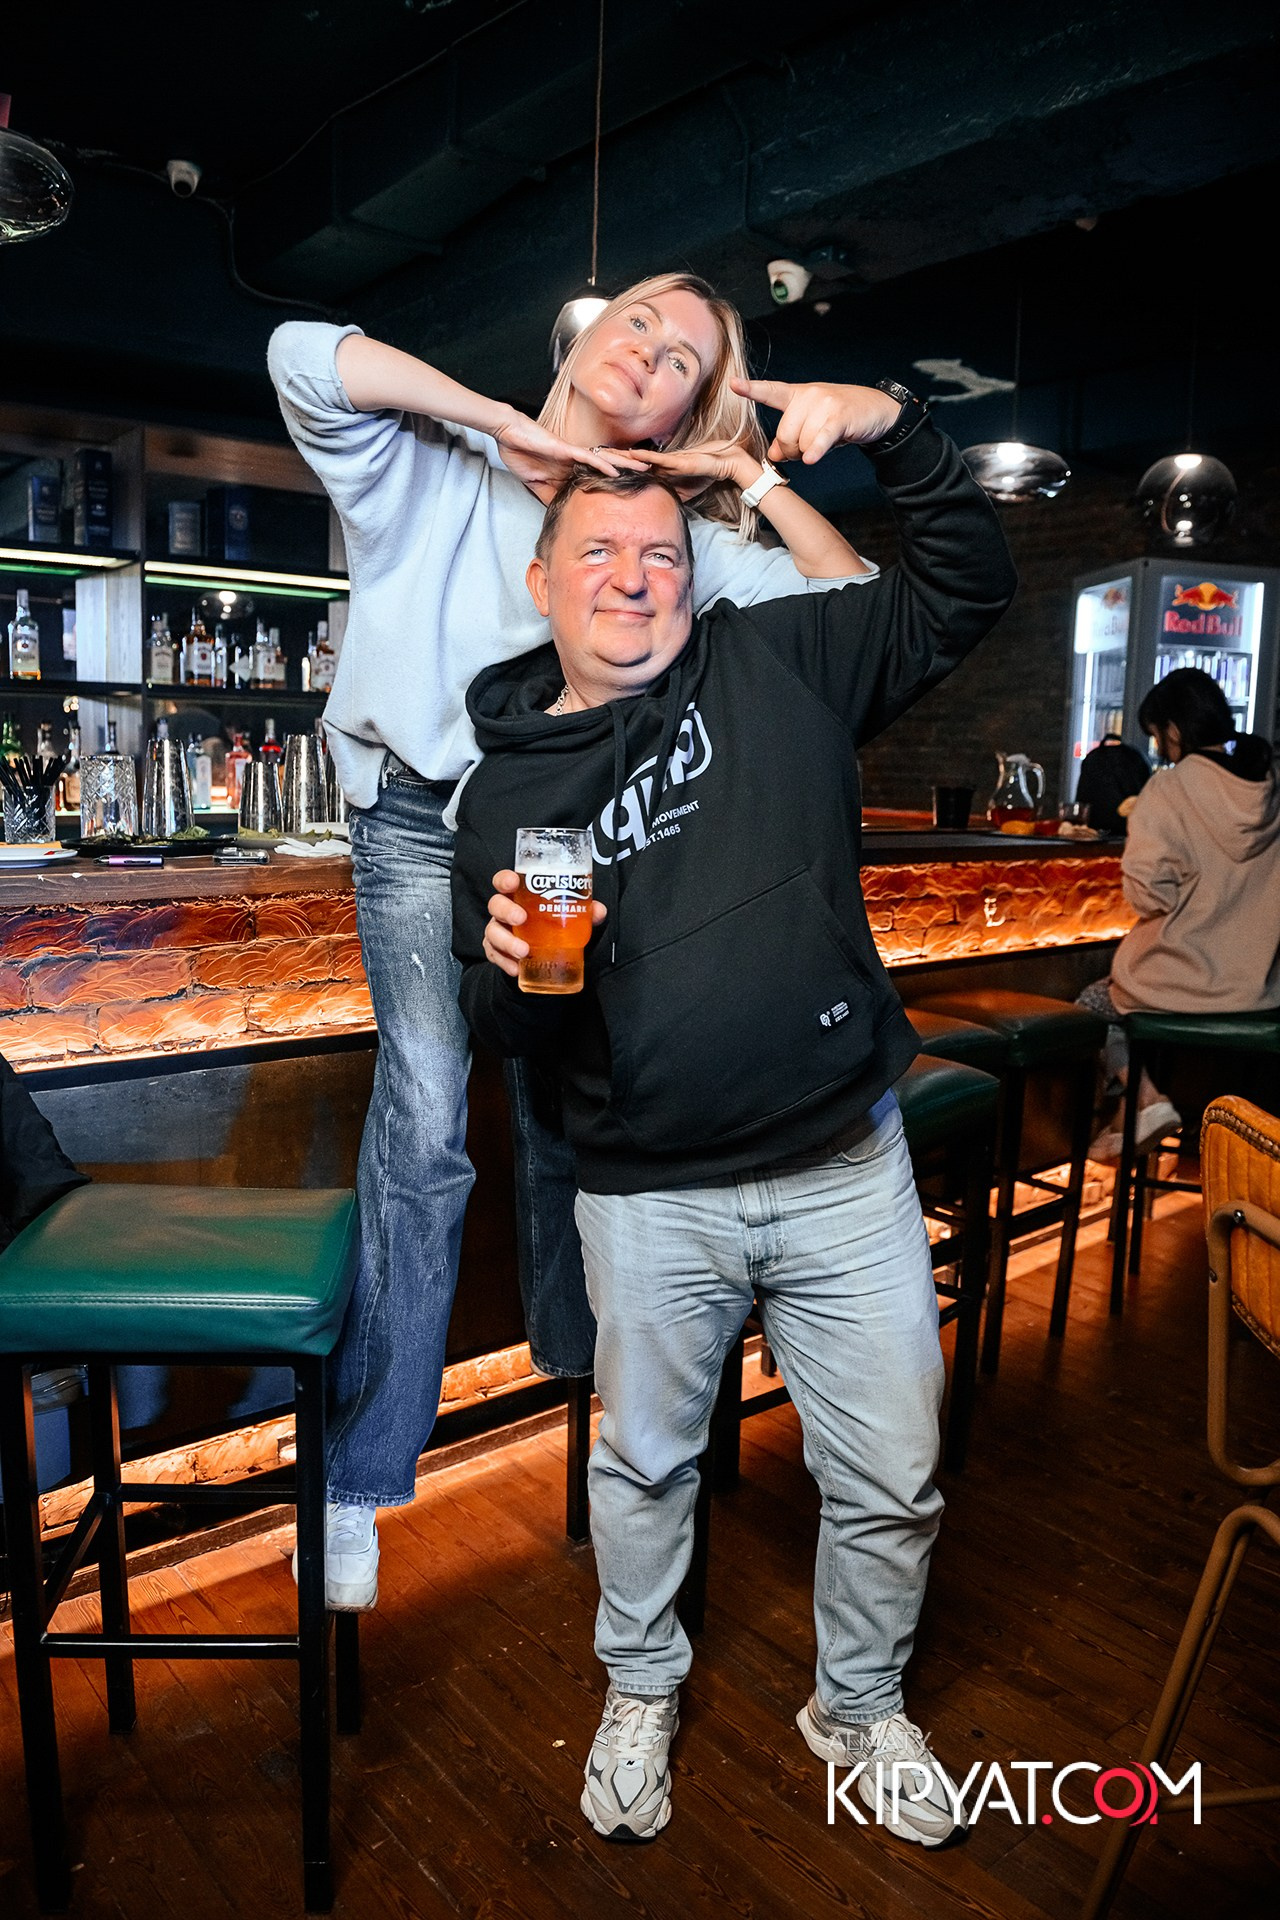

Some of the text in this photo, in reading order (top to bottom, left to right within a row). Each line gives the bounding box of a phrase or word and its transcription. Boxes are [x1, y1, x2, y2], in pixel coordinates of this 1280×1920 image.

[1163, 610, 1243, 636] Red Bull
[652, 800, 700, 829] MOVEMENT
[643, 823, 681, 851] ST.1465
[539, 903, 587, 913] DENMARK
